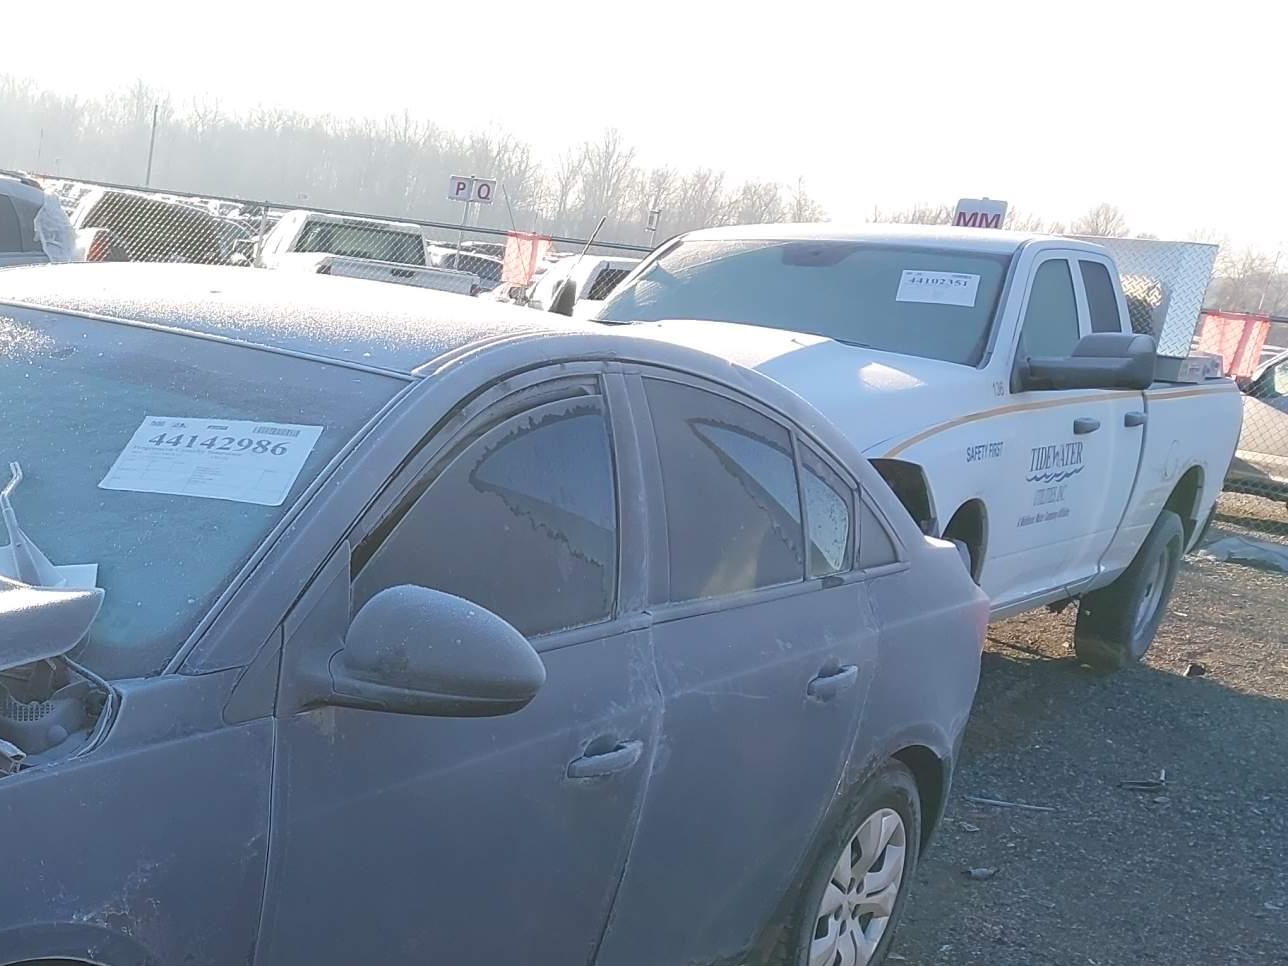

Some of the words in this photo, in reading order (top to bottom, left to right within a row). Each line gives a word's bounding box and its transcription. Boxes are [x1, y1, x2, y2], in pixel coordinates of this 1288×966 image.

[455, 181, 466, 196] P
[477, 183, 491, 200] Q
[955, 211, 1001, 228] MM
[148, 433, 290, 455] 44142986
[966, 444, 988, 462] SAFETY
[1030, 442, 1083, 472] TIDEWATER
